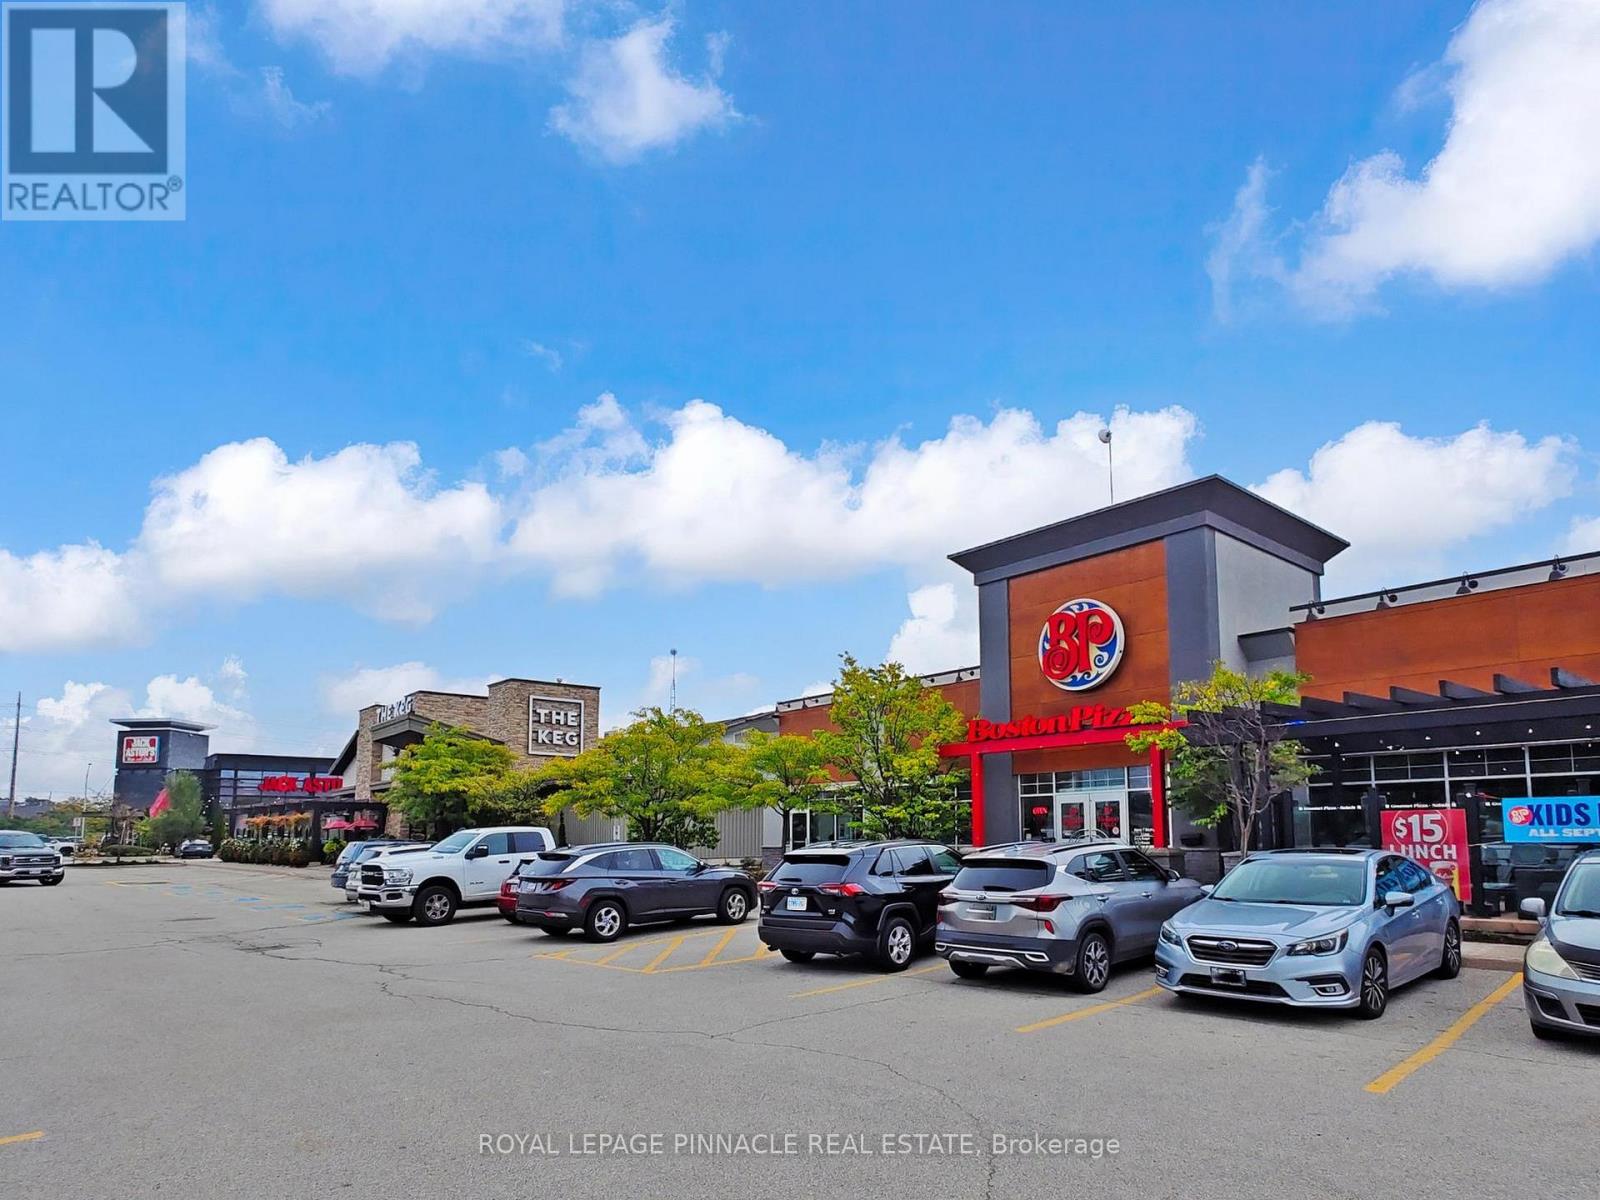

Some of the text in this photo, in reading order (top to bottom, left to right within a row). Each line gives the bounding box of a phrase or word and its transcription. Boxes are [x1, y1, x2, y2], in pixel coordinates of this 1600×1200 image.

[375, 704, 395, 725] THE
[535, 708, 578, 727] THE
[537, 729, 578, 746] KEG
[1527, 803, 1591, 827] KIDS
[1394, 813, 1444, 843] $15
[1528, 828, 1559, 837] ALL
